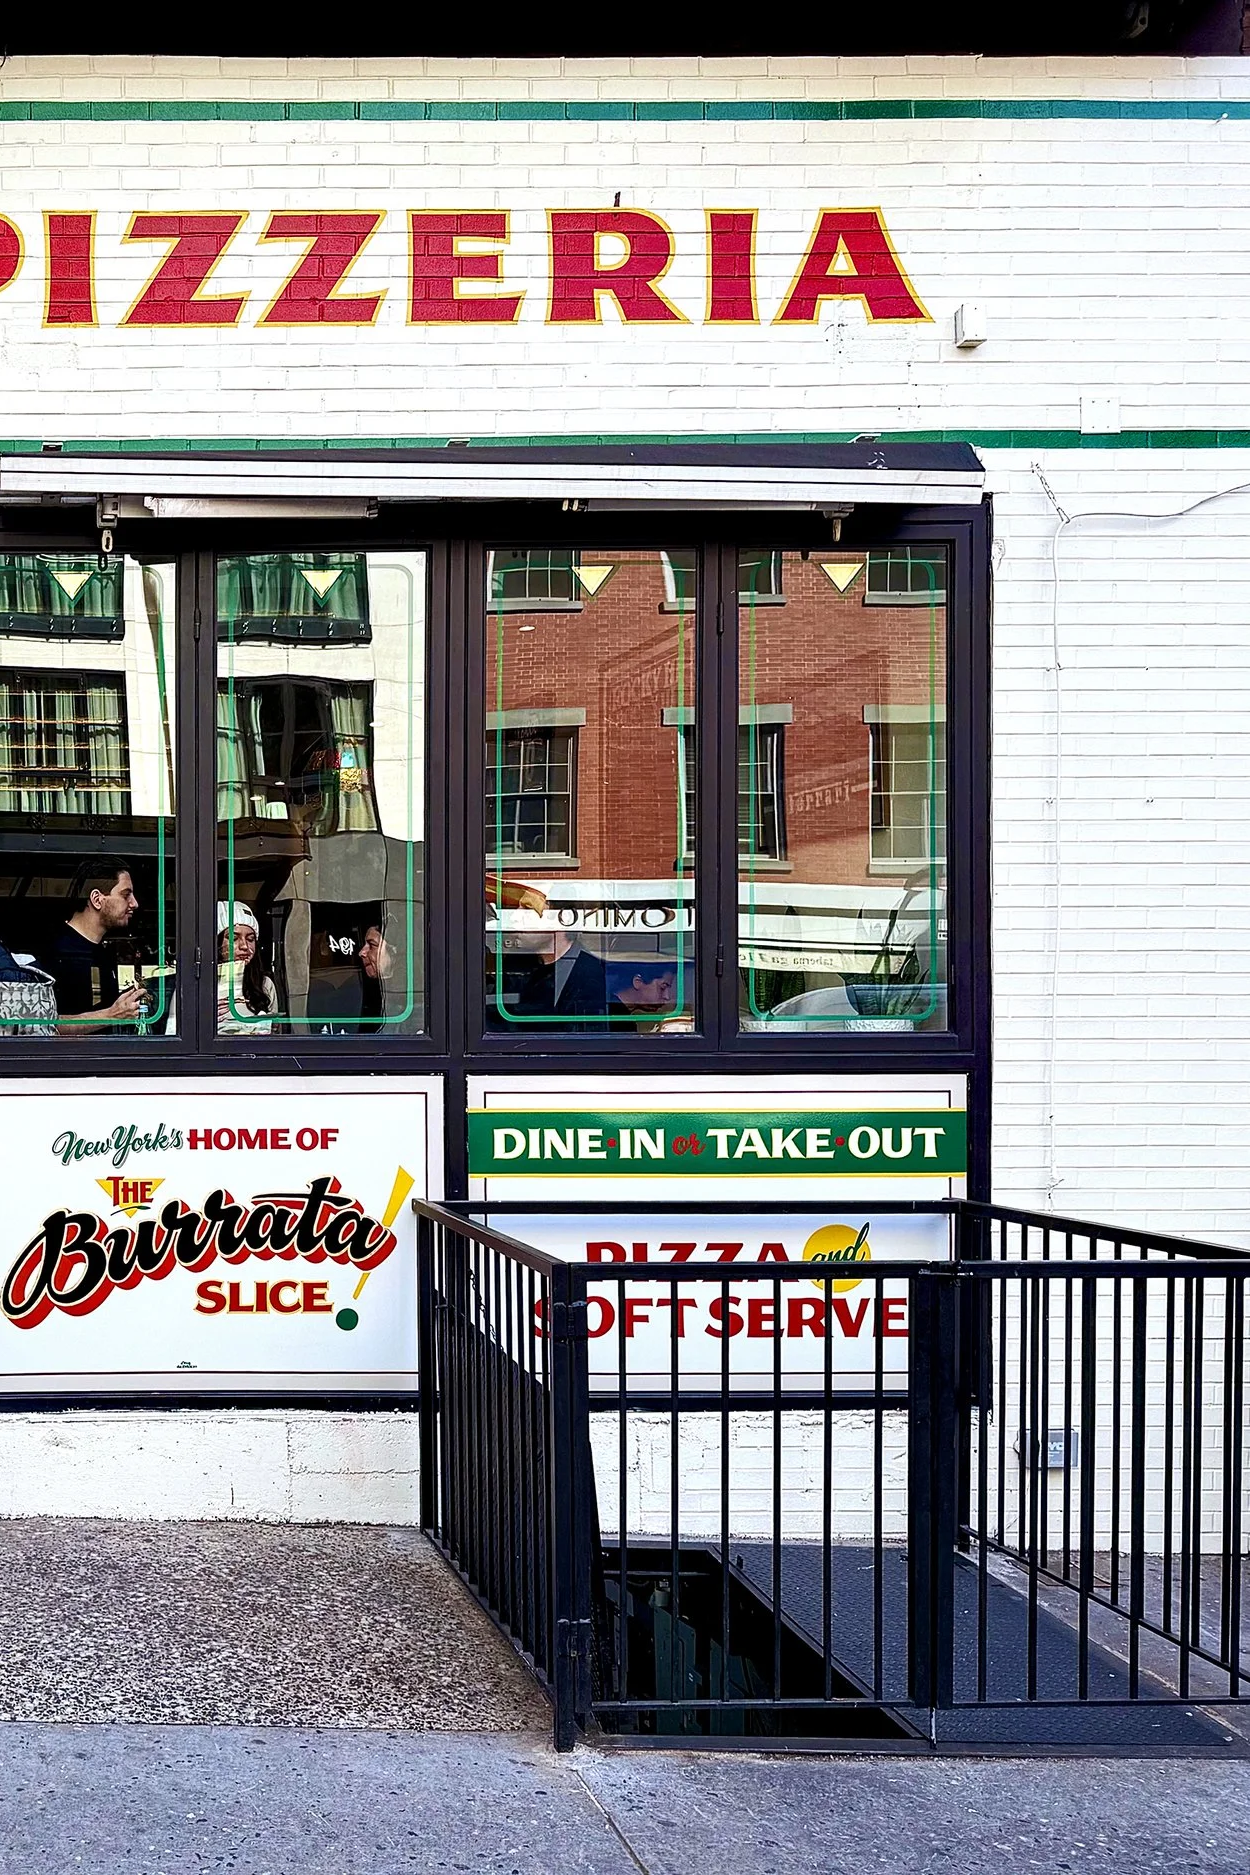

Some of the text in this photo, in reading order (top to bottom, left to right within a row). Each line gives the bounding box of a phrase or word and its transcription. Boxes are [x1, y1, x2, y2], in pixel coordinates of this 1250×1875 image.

[51, 1122, 339, 1170] New York's HOME OF
[671, 1135, 706, 1157] or
[106, 1175, 155, 1206] THE
[704, 1296, 909, 1339] SERVE
